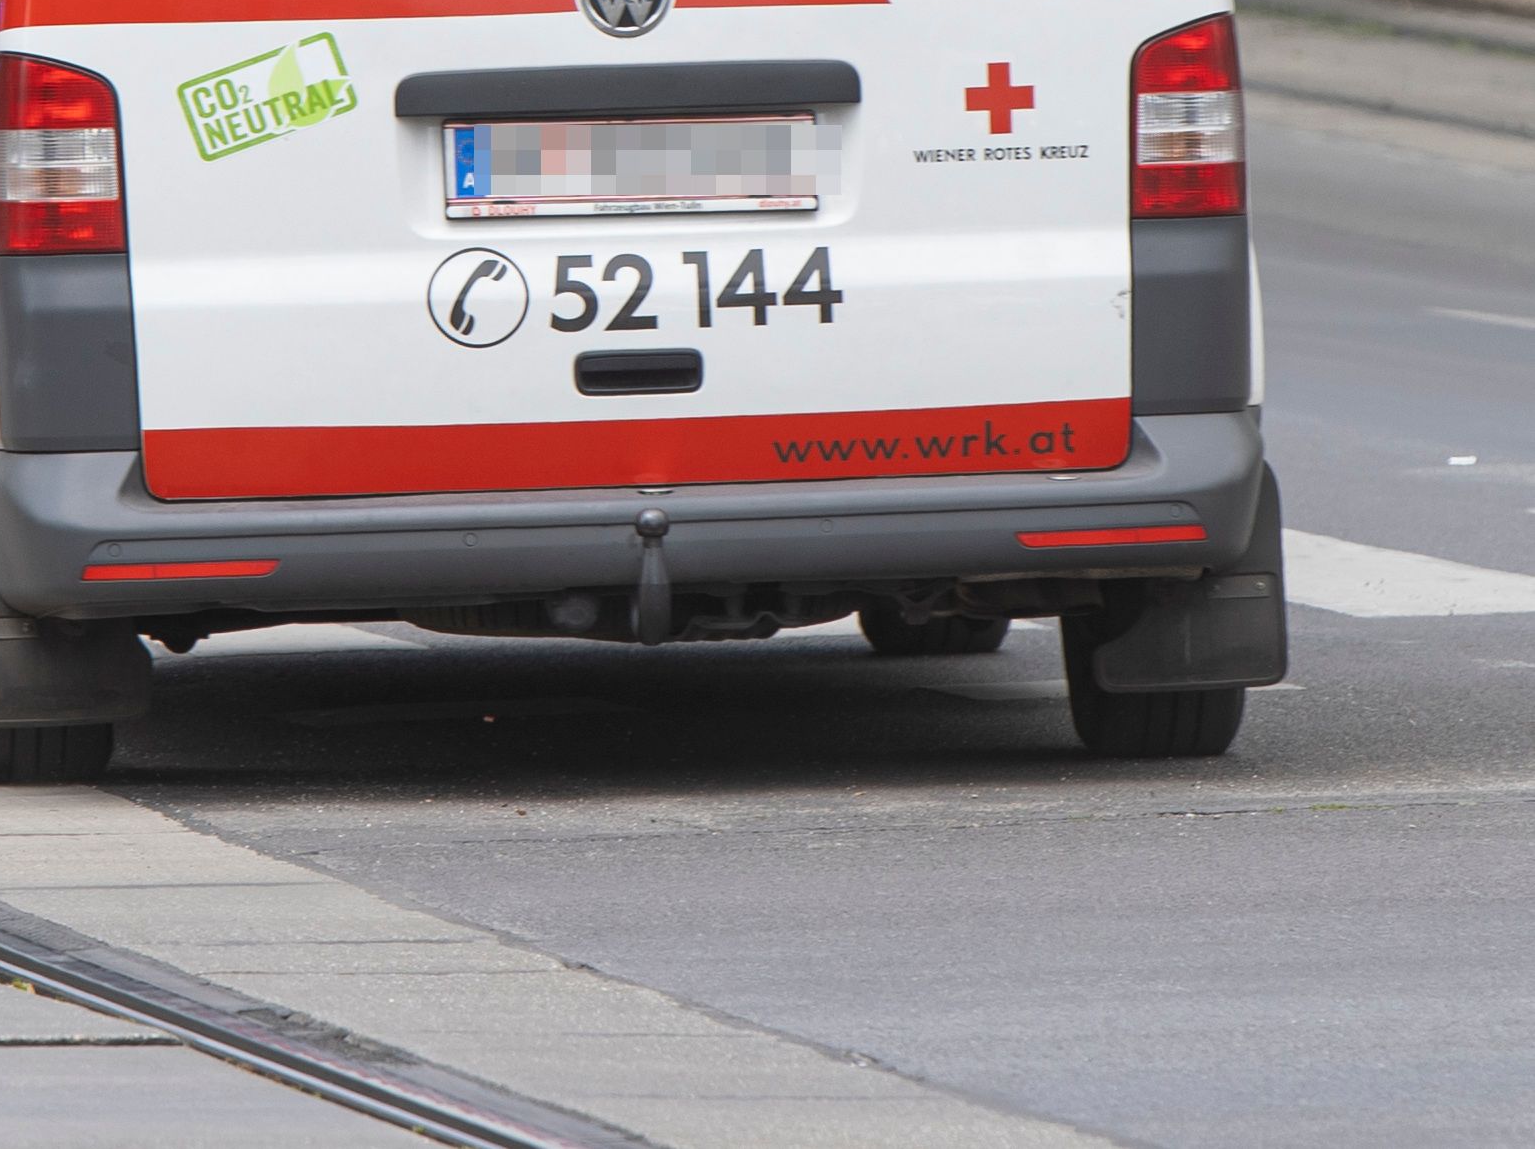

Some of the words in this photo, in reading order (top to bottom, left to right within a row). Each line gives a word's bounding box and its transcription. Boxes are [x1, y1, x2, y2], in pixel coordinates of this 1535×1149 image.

[202, 79, 345, 150] NEUTRAL
[913, 149, 976, 163] WIENER
[983, 147, 1032, 161] ROTES
[1039, 144, 1090, 160] KREUZ
[550, 253, 658, 333] 52
[681, 246, 843, 329] 144
[772, 420, 1076, 463] www.wrk.at
